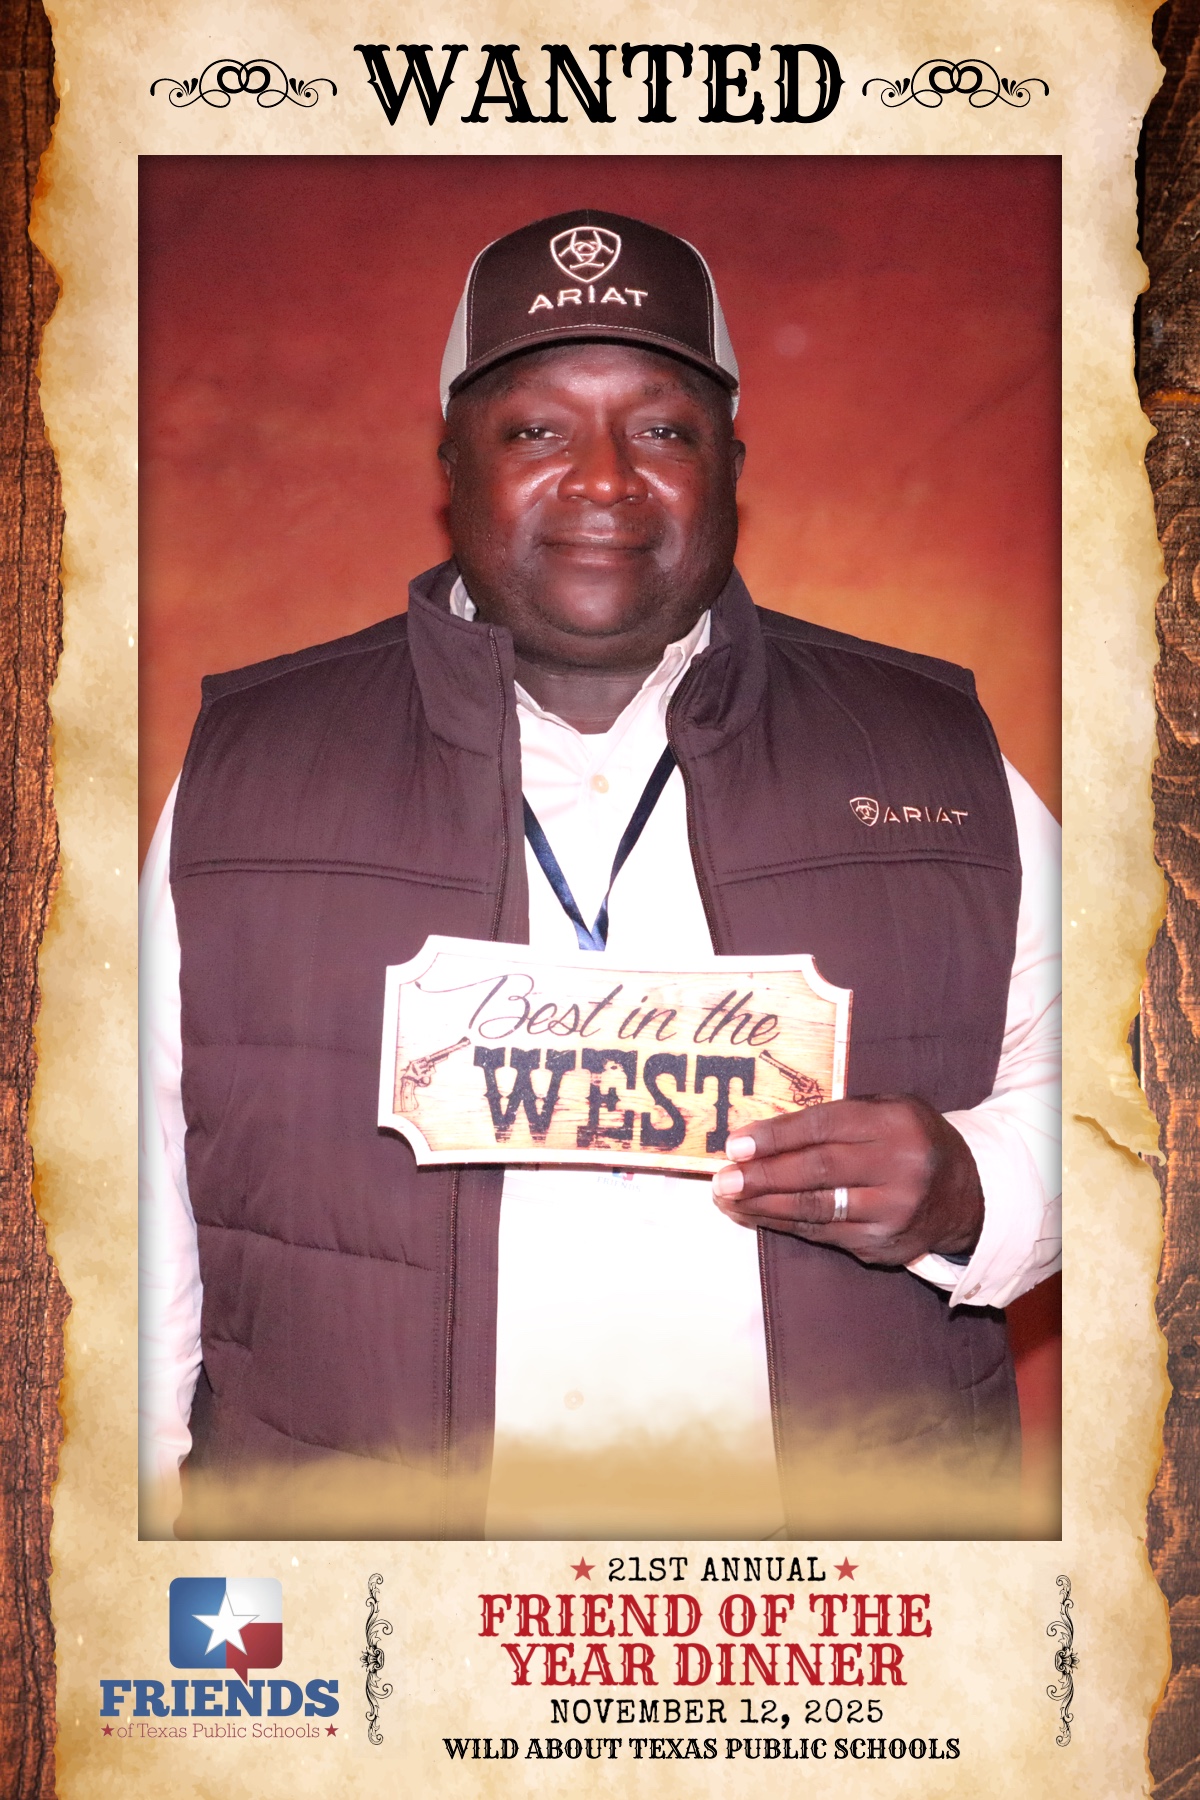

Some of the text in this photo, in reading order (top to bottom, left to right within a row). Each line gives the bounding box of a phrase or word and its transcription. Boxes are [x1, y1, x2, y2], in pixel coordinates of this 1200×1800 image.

[528, 285, 649, 314] ARIAT
[884, 806, 968, 825] ARIAT
[415, 974, 781, 1047] Best in the
[473, 1047, 756, 1154] WEST
